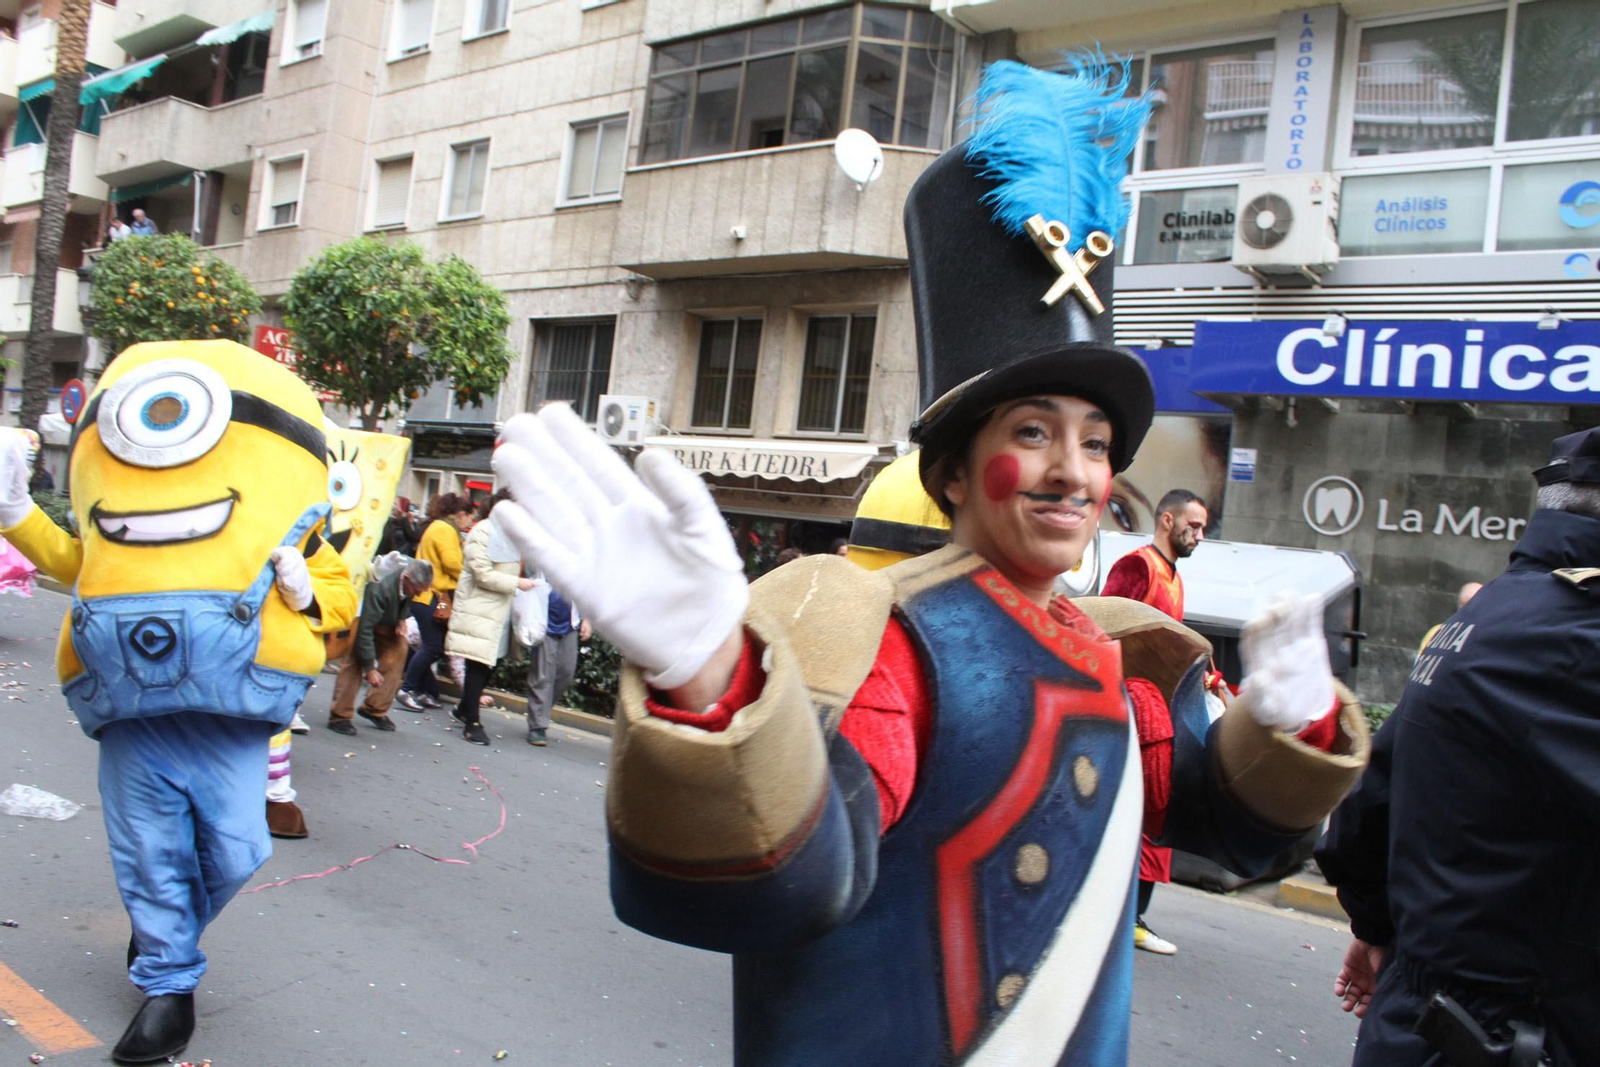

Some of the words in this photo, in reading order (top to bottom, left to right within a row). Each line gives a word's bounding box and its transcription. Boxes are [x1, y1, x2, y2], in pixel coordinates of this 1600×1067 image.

[1286, 13, 1314, 169] LABORATORIO
[1375, 196, 1447, 212] Análisis
[1374, 215, 1446, 232] Clínicos
[1276, 327, 1600, 392] Clínica
[674, 449, 713, 470] BAR
[1377, 499, 1422, 533] La
[1433, 503, 1527, 541] Mer
